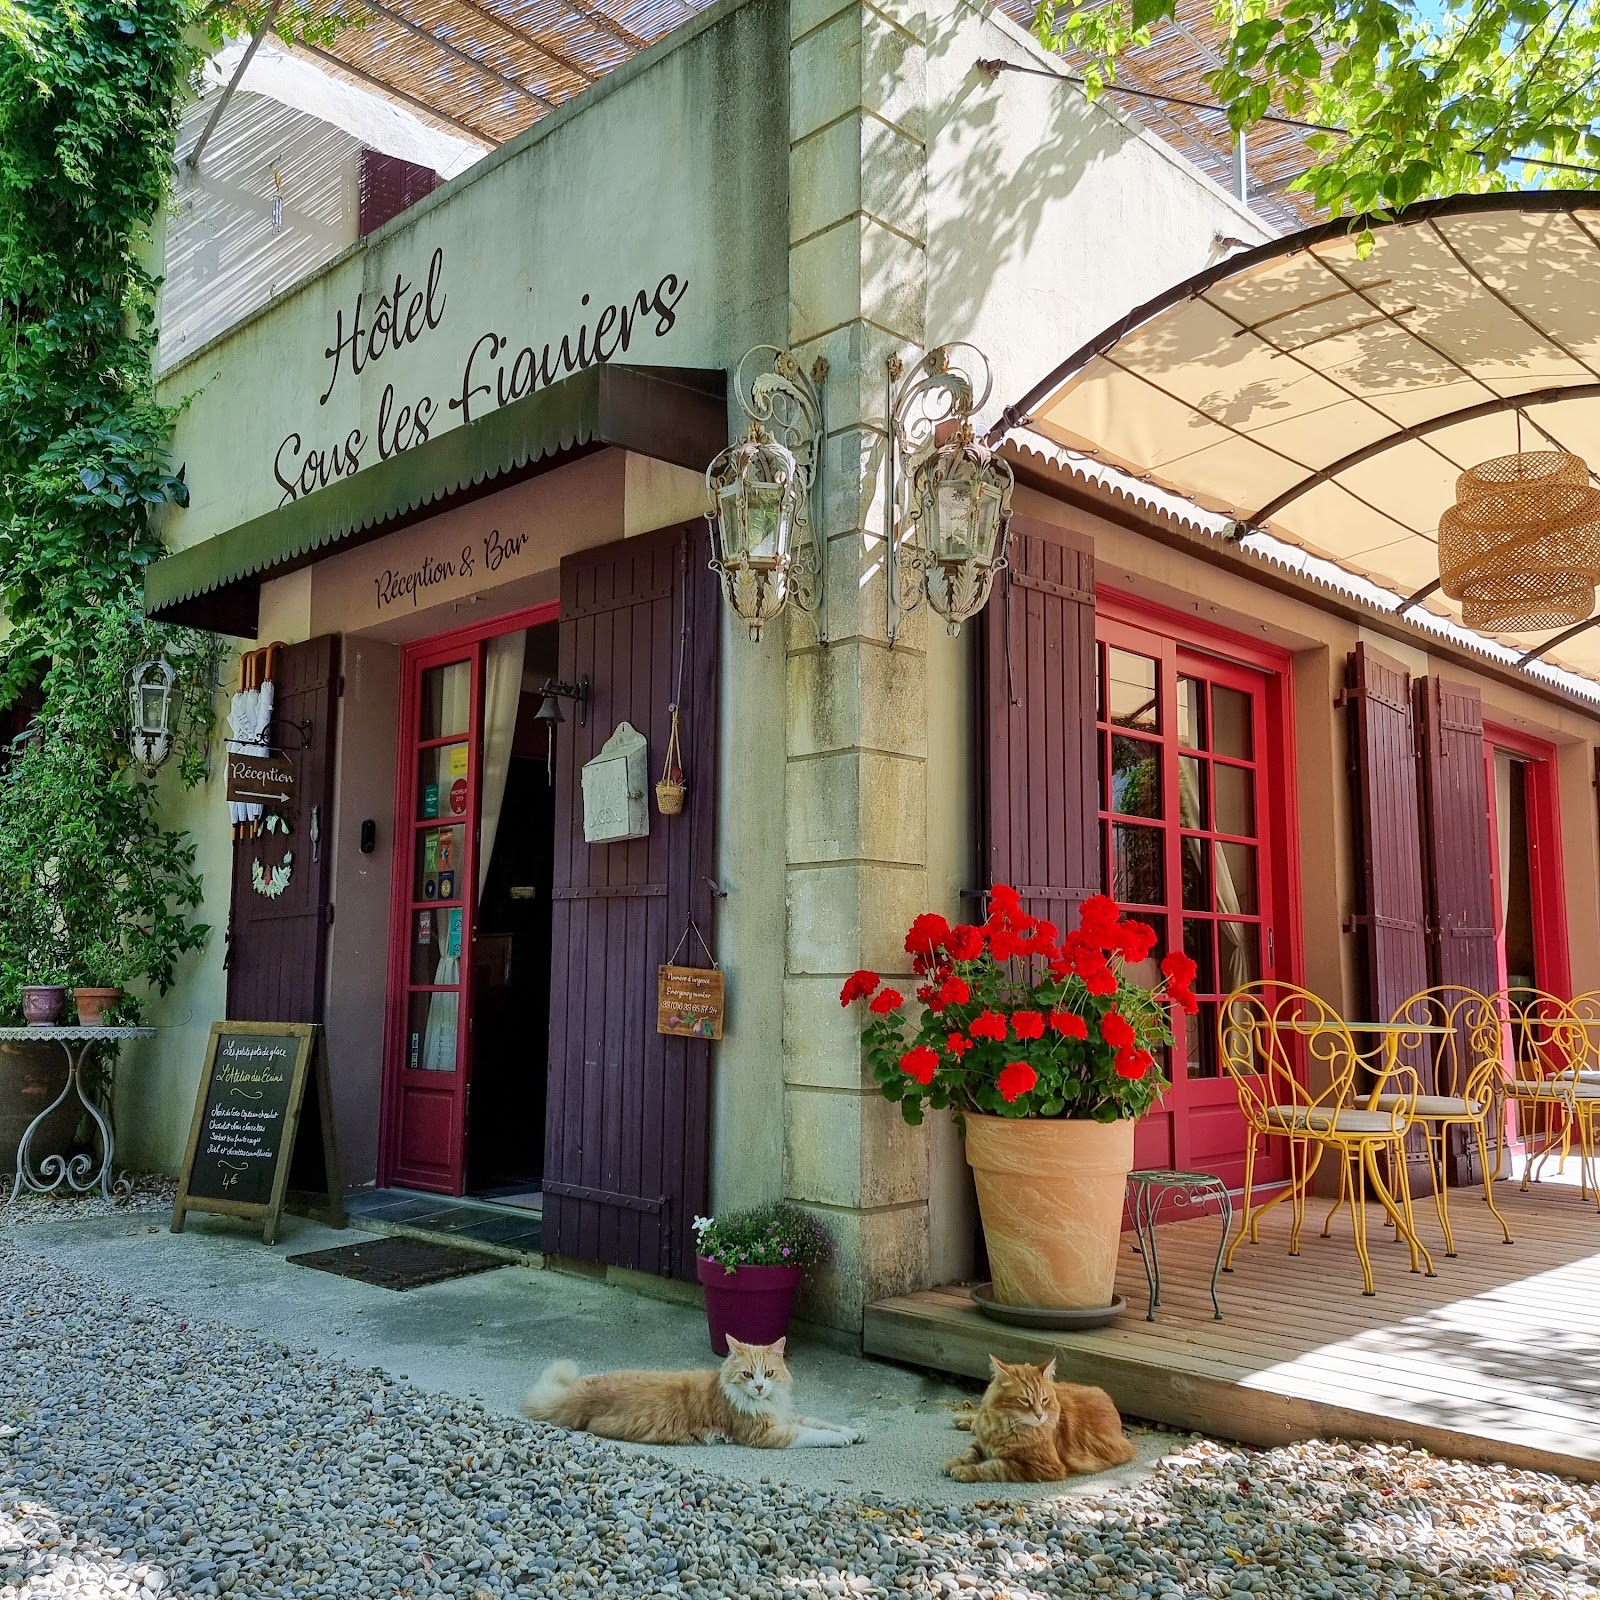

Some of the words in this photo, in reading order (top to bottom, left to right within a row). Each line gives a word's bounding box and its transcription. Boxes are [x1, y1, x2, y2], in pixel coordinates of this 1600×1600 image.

[320, 247, 447, 406] Hôtel
[273, 432, 369, 508] Sous
[377, 384, 439, 461] les
[374, 556, 456, 609] Réception
[459, 545, 475, 577] &
[483, 529, 529, 571] Bar
[230, 762, 294, 787] Réception
